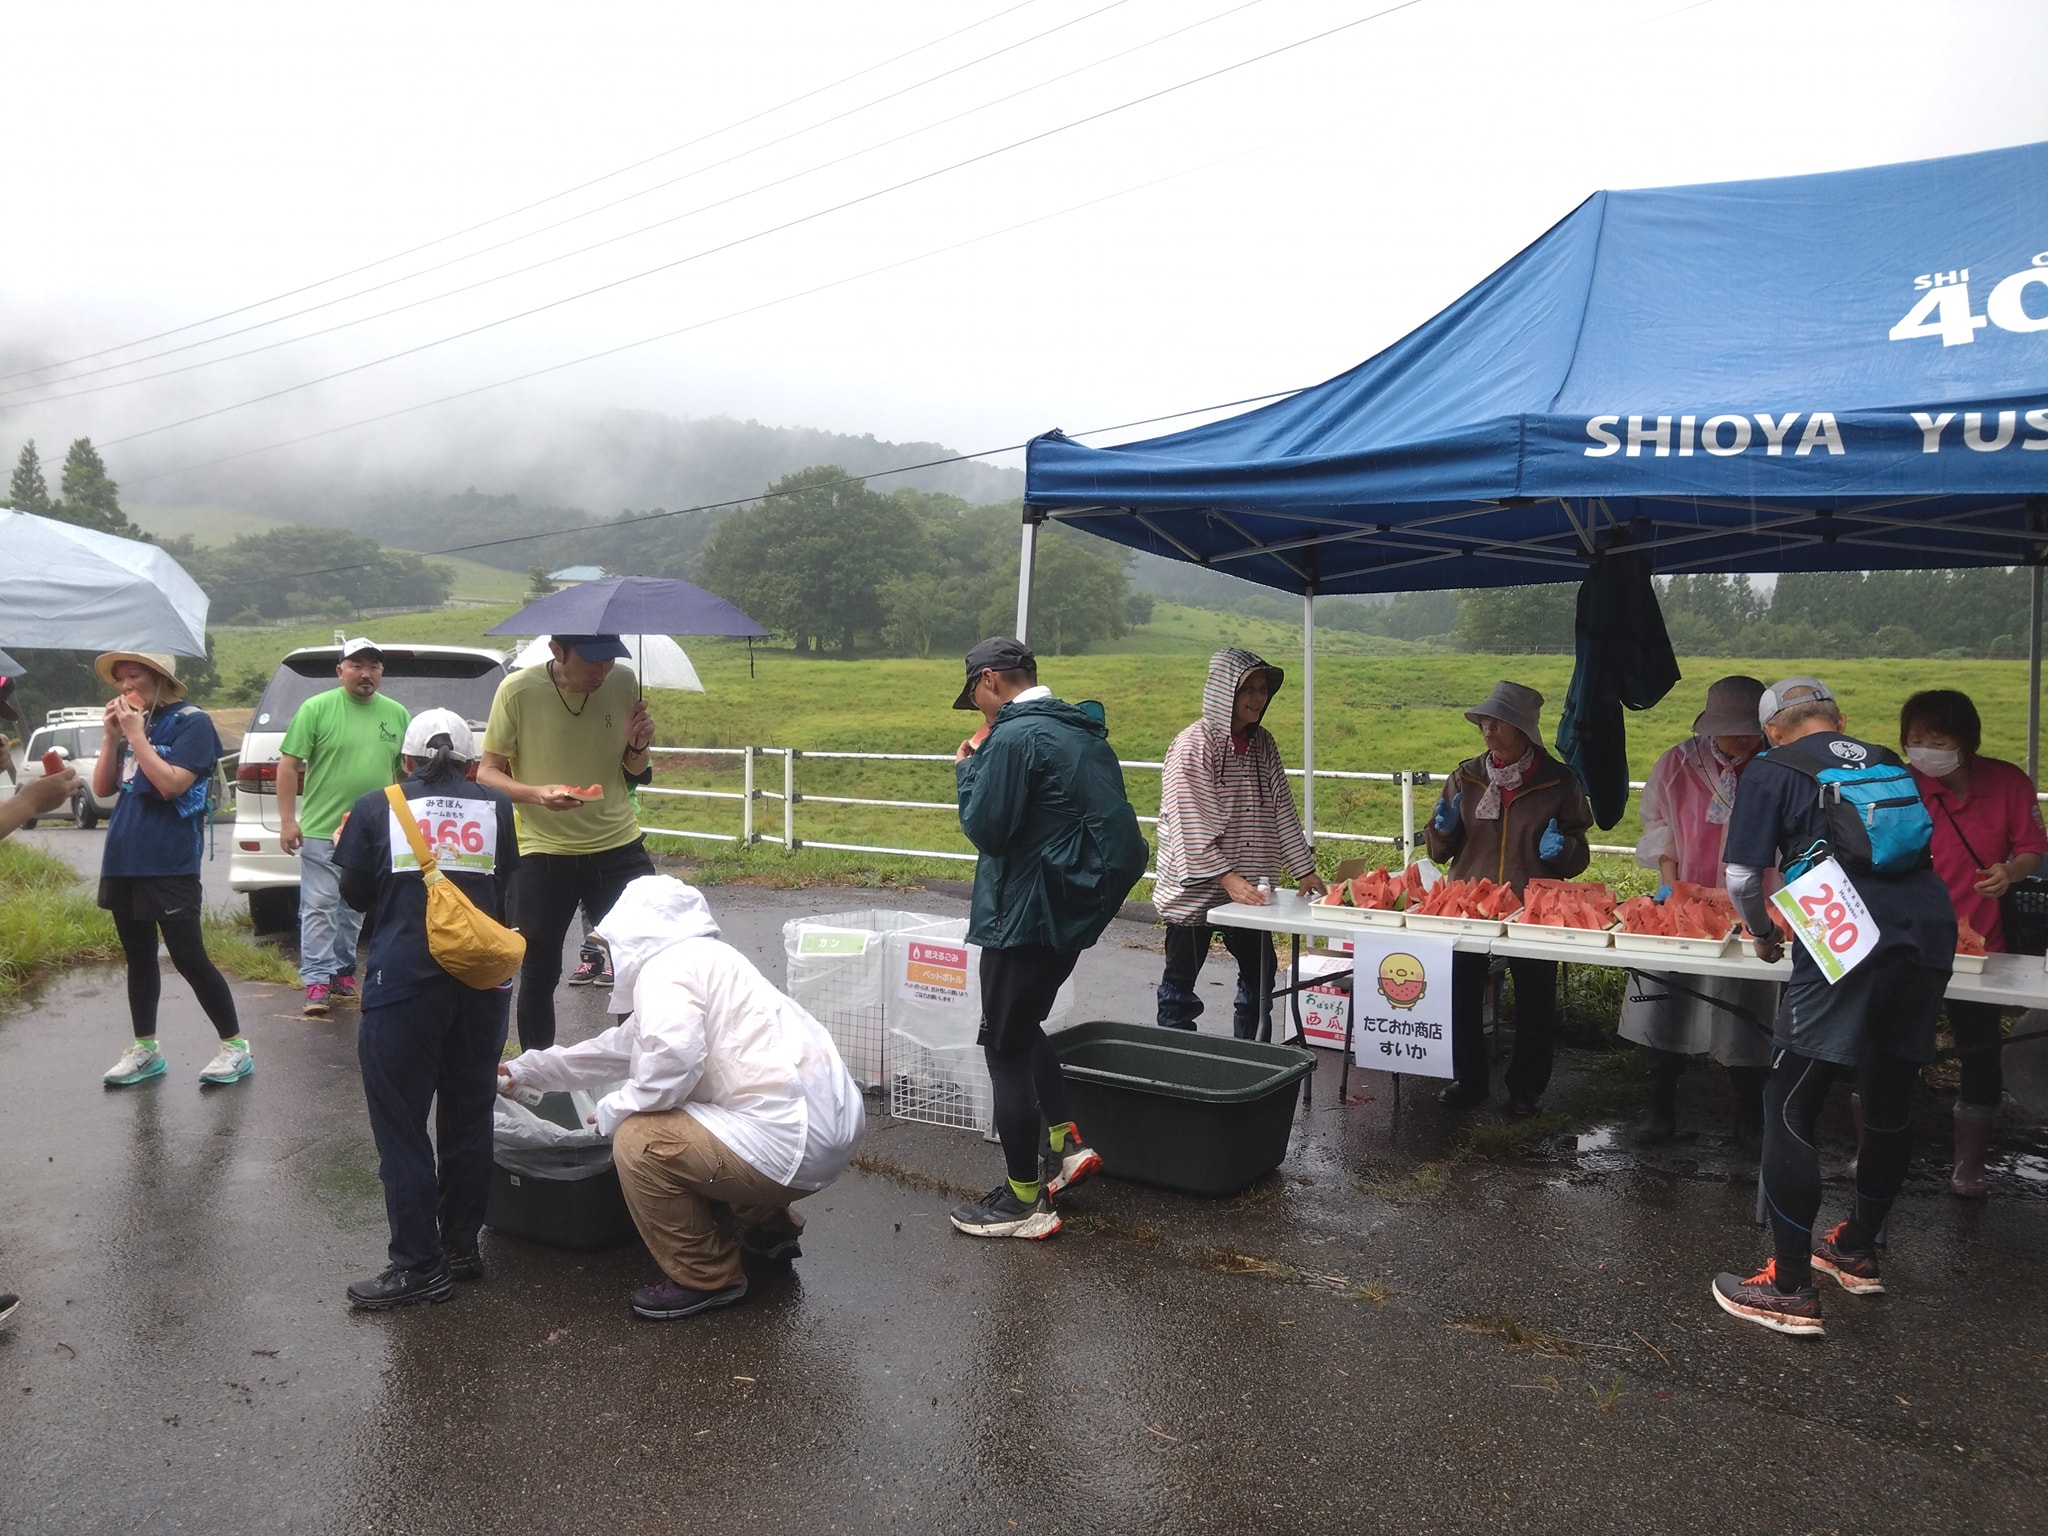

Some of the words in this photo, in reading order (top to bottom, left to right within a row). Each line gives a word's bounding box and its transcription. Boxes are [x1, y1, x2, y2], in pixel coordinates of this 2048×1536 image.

[1913, 268, 1970, 290] SHI
[1583, 412, 1847, 457] SHIOYA
[1910, 408, 2048, 453] YUS
[416, 819, 484, 853] 466
[1798, 883, 1859, 954] 290
[819, 938, 841, 948] カン
[924, 949, 959, 963] 燃えるごみ
[922, 970, 963, 985] ペットボトル
[1306, 1011, 1343, 1031] 西瓜
[1363, 1016, 1443, 1040] たておか商店
[1379, 1041, 1427, 1059] すいか
